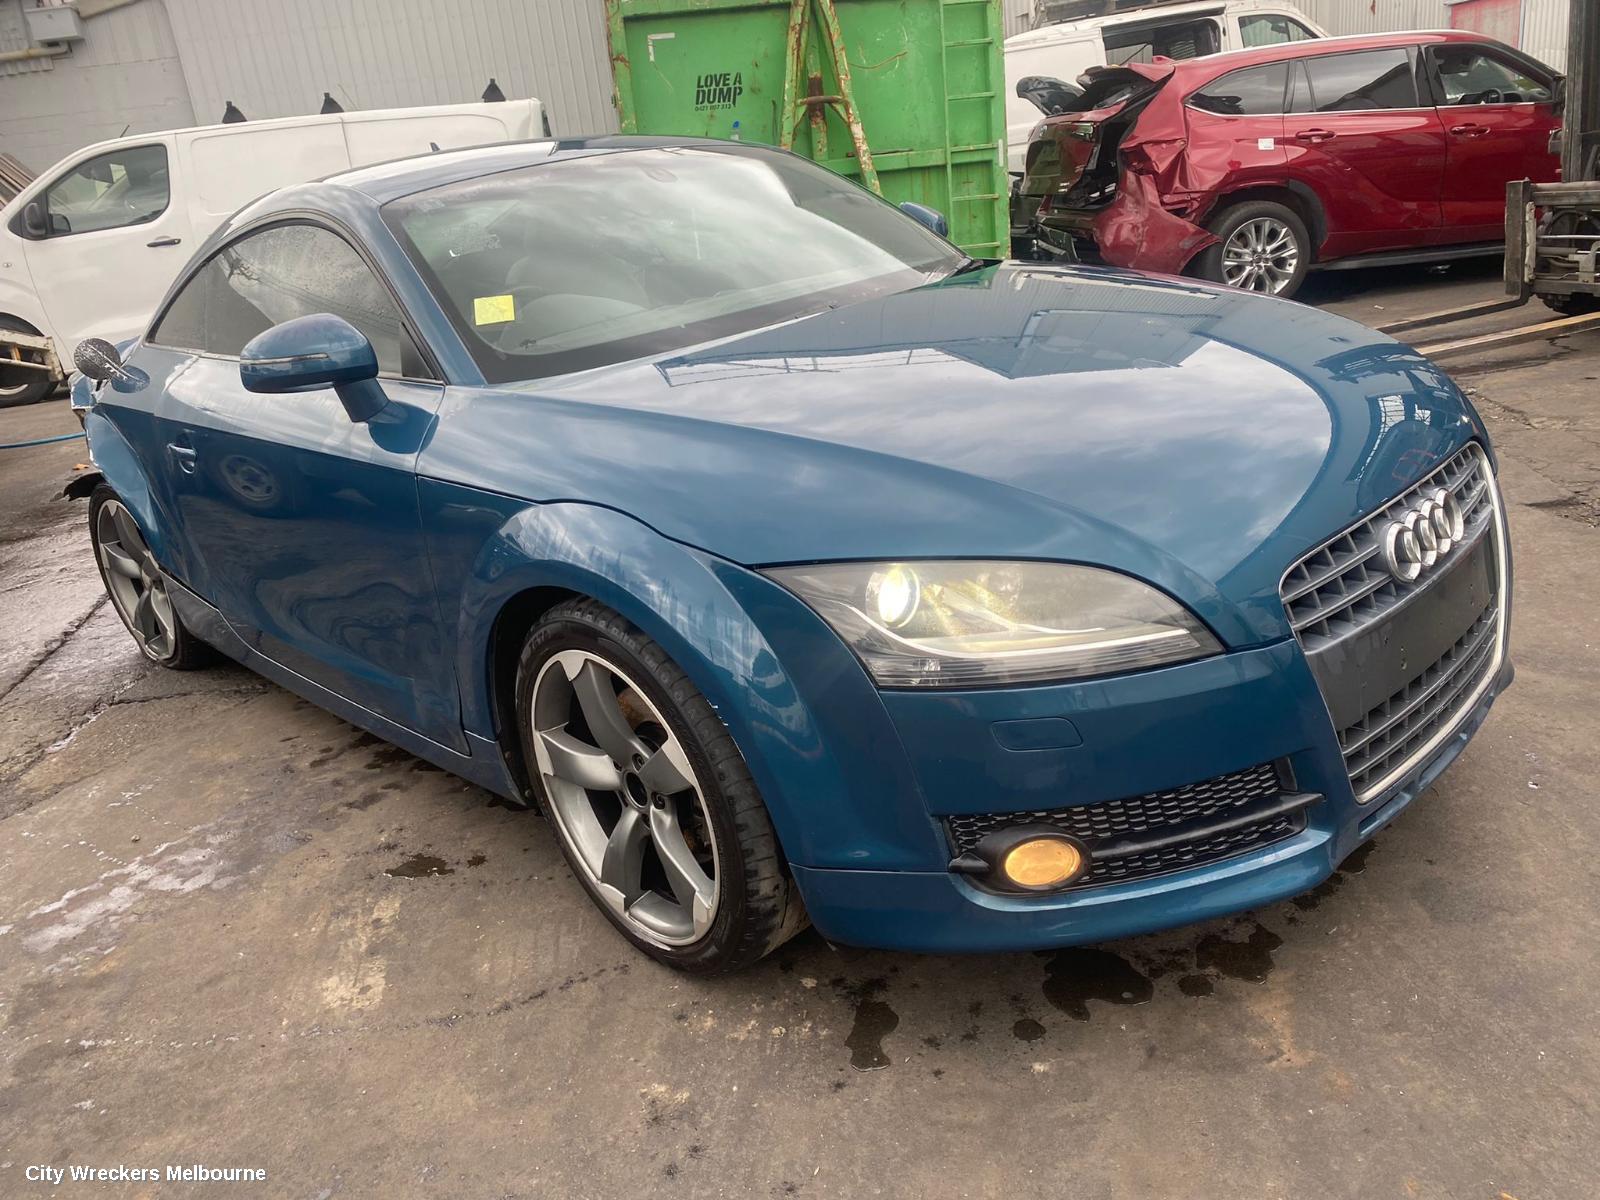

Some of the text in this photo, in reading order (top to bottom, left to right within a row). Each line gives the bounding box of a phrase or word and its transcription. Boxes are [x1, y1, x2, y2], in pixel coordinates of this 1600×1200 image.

[697, 72, 742, 88] LOVE A
[696, 86, 743, 107] DUMP
